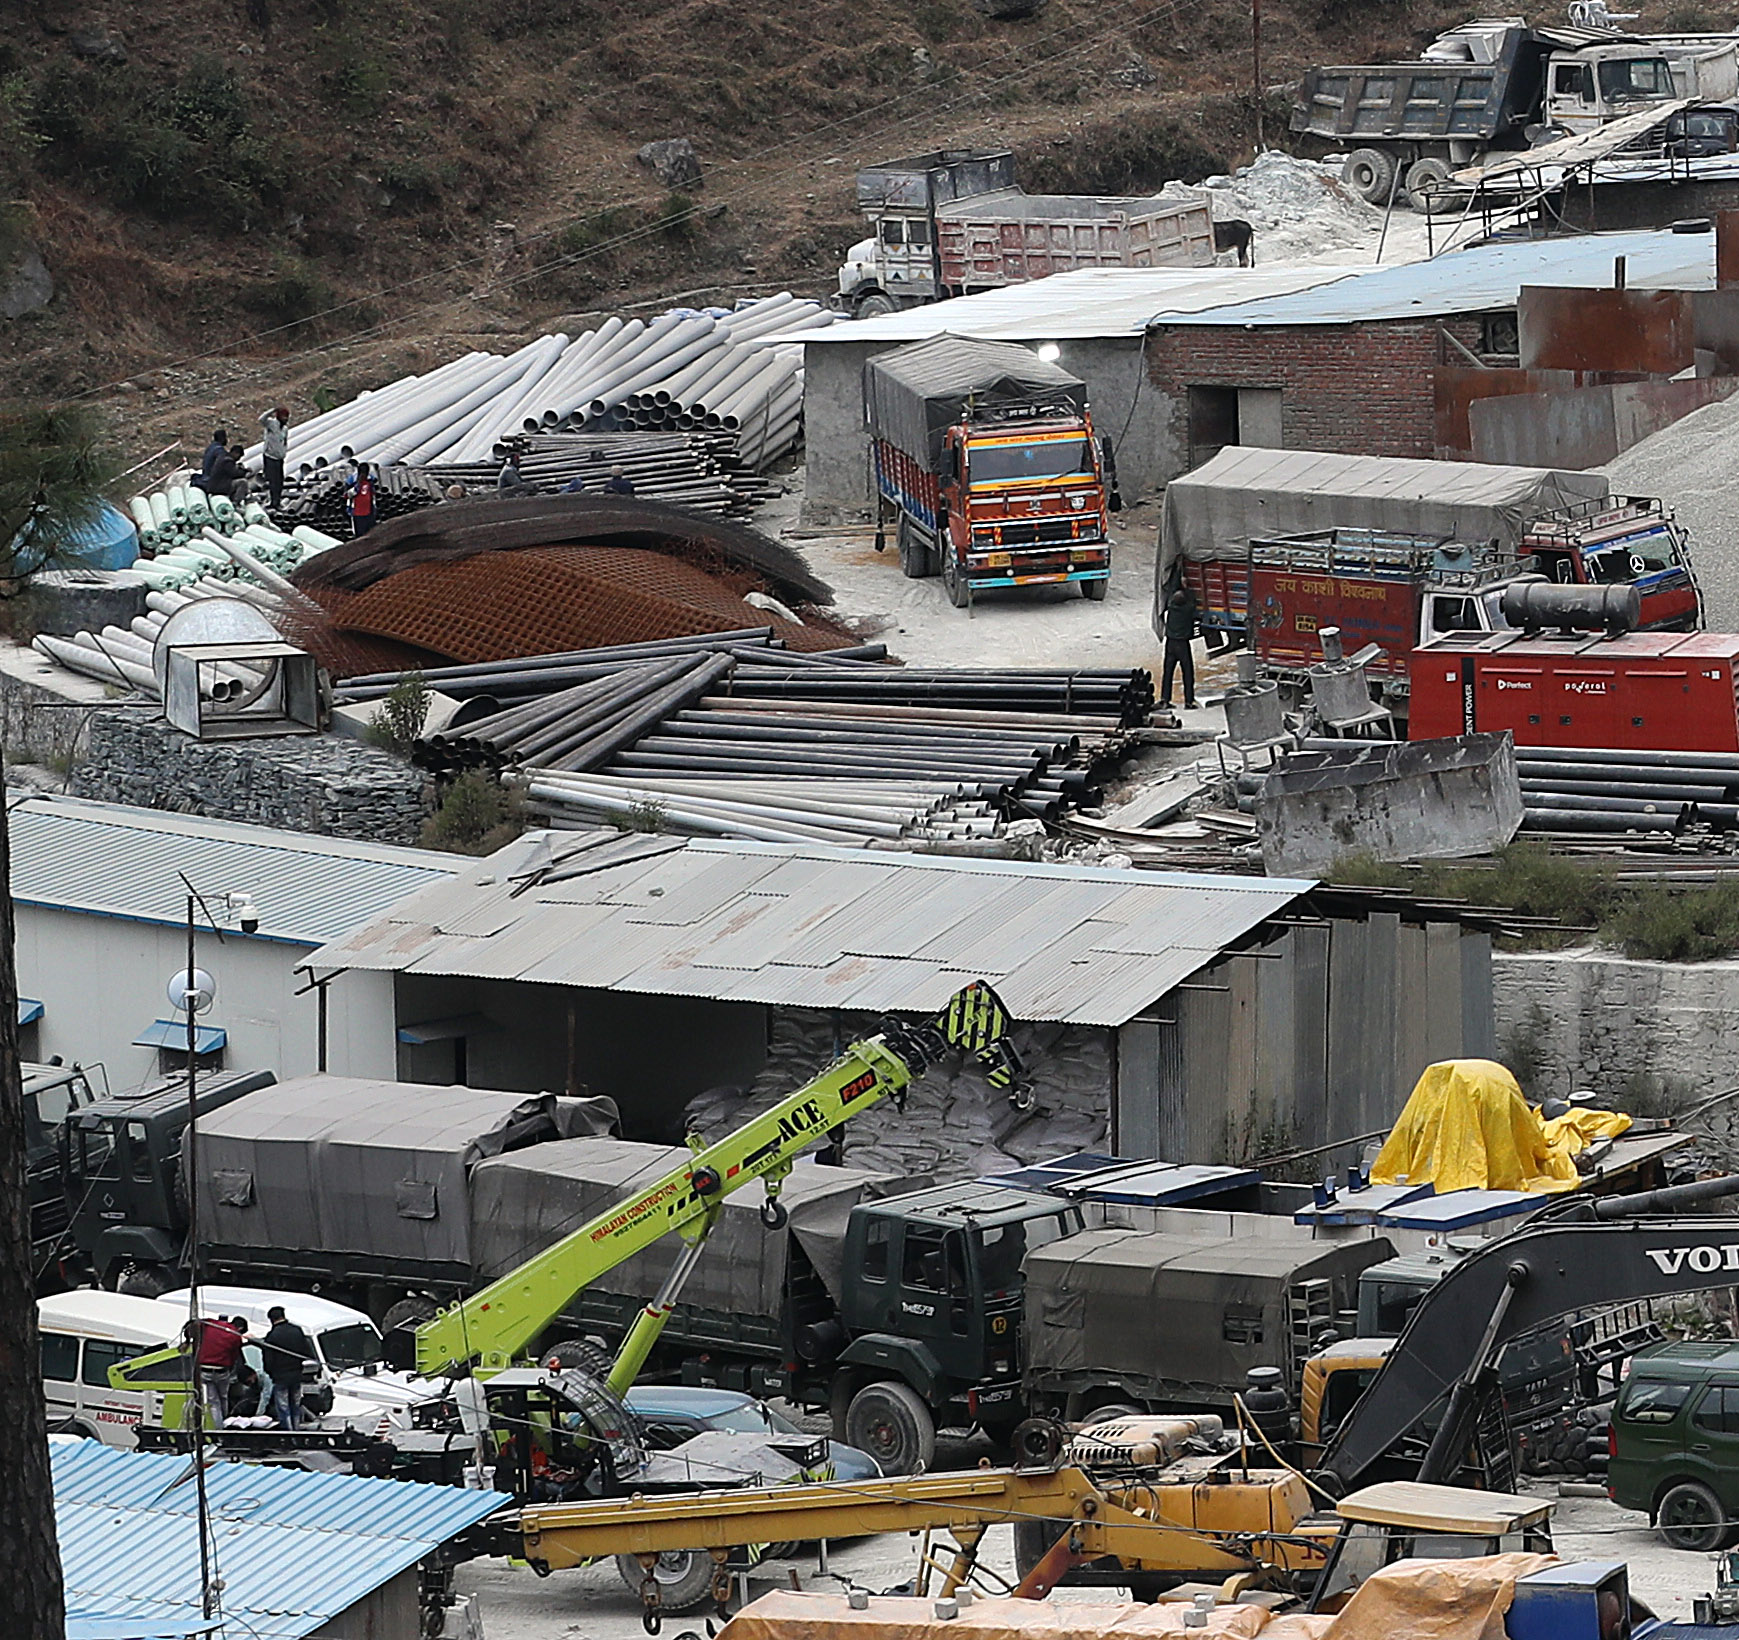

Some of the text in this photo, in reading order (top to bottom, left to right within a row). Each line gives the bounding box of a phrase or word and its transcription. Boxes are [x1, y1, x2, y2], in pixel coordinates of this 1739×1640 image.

[1274, 578, 1297, 593] जय
[1302, 578, 1335, 597] काशी
[1464, 683, 1473, 714] POWER
[842, 1074, 873, 1101] F210
[777, 1098, 826, 1143] ACE
[589, 1183, 678, 1243] HIMALAYAN CONSTRUCTION
[1525, 1378, 1548, 1392] TATA
